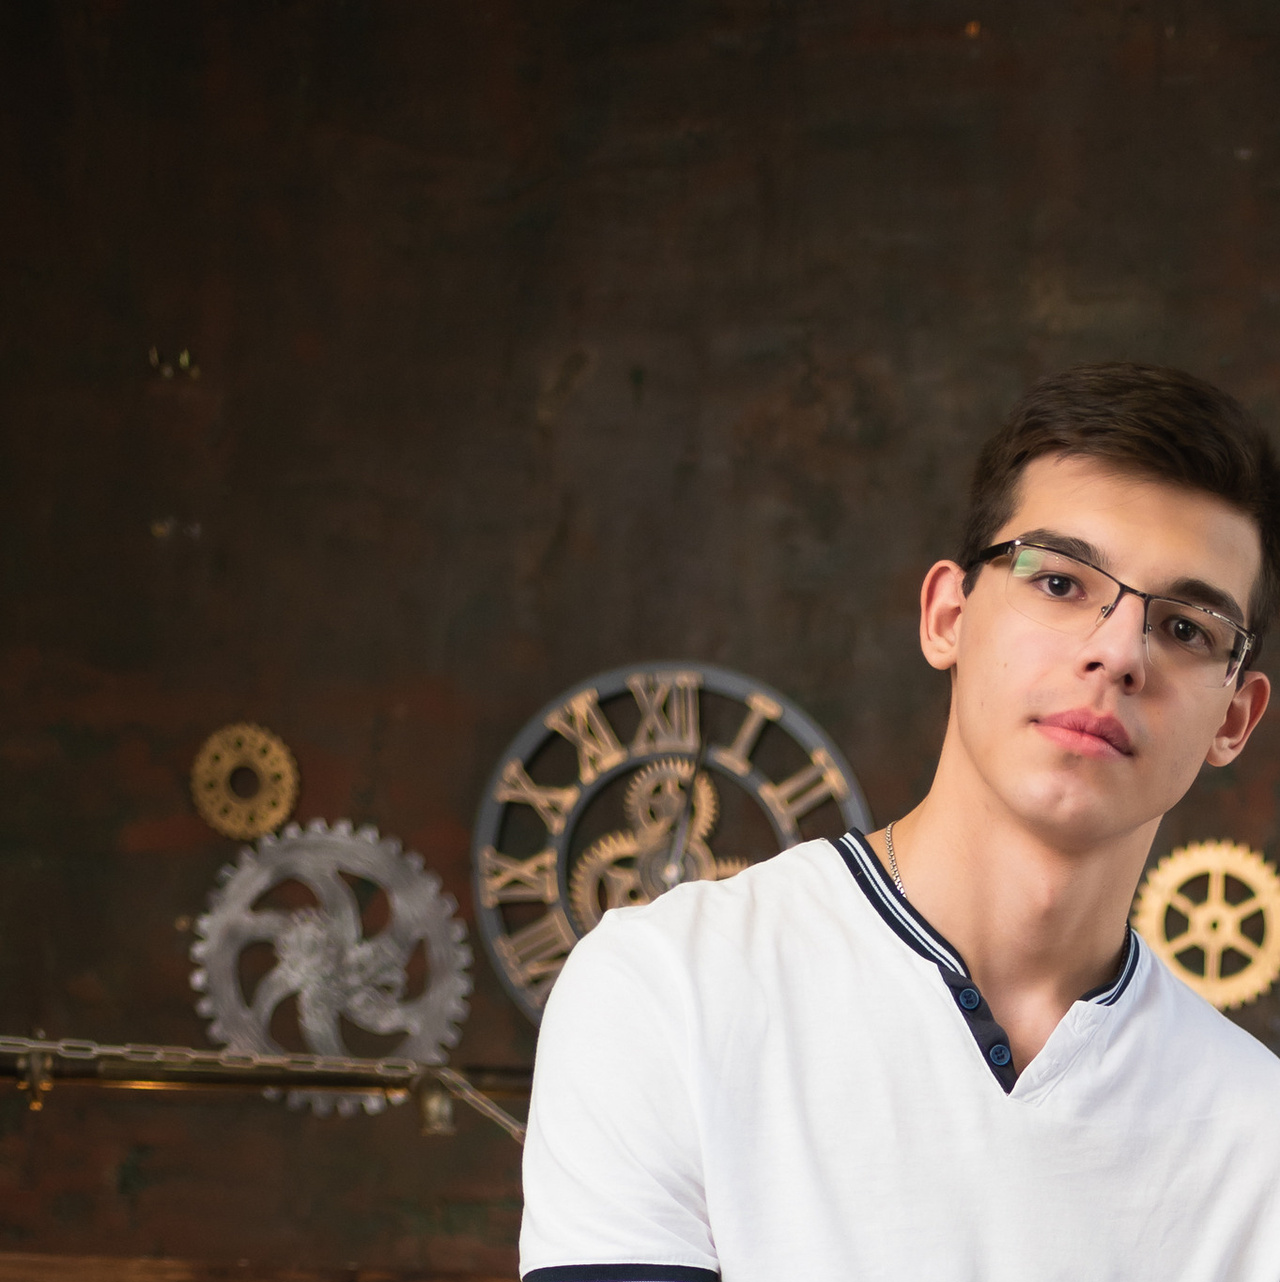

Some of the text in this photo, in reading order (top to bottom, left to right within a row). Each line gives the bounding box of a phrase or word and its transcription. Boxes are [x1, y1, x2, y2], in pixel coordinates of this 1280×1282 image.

[544, 689, 629, 785] XI
[626, 671, 704, 754] XII
[494, 759, 580, 834] X
